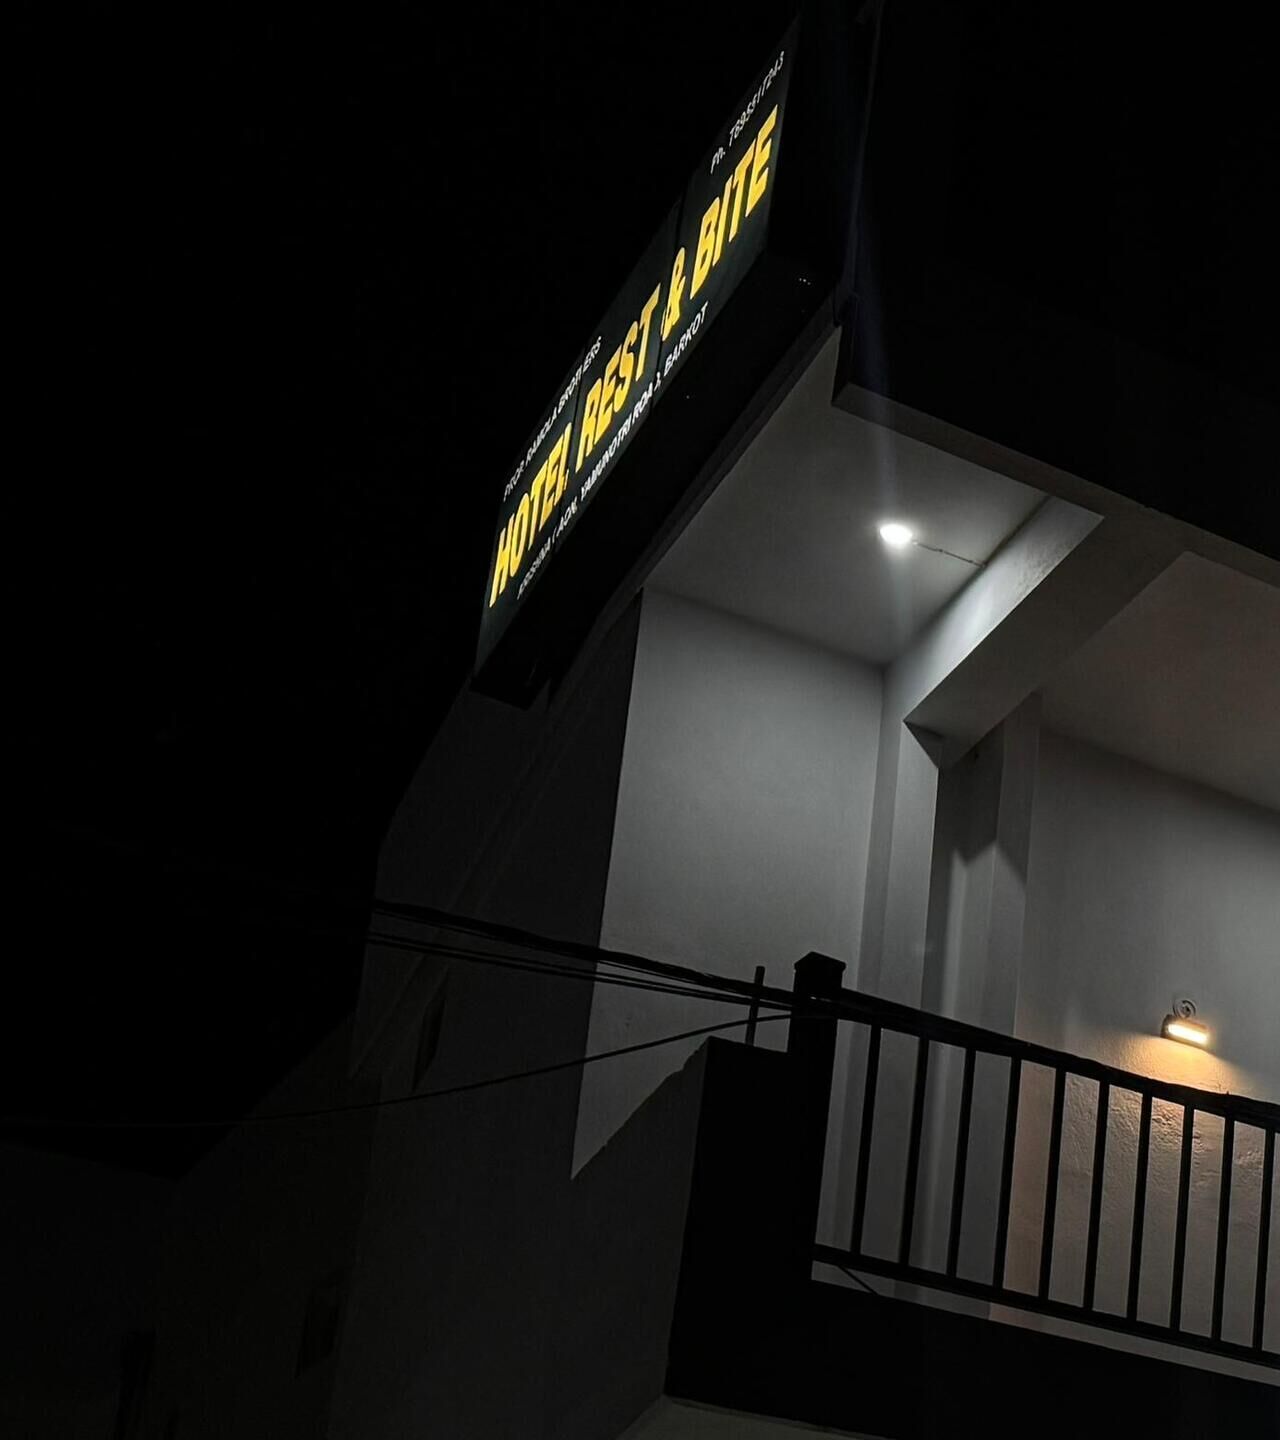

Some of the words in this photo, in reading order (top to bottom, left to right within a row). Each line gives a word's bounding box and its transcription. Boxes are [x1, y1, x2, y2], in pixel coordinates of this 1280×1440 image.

[489, 422, 573, 608] HOTEL
[575, 283, 661, 474] REST
[661, 247, 686, 342] &
[690, 104, 778, 300] BITE
[664, 301, 709, 377] BARKOT
